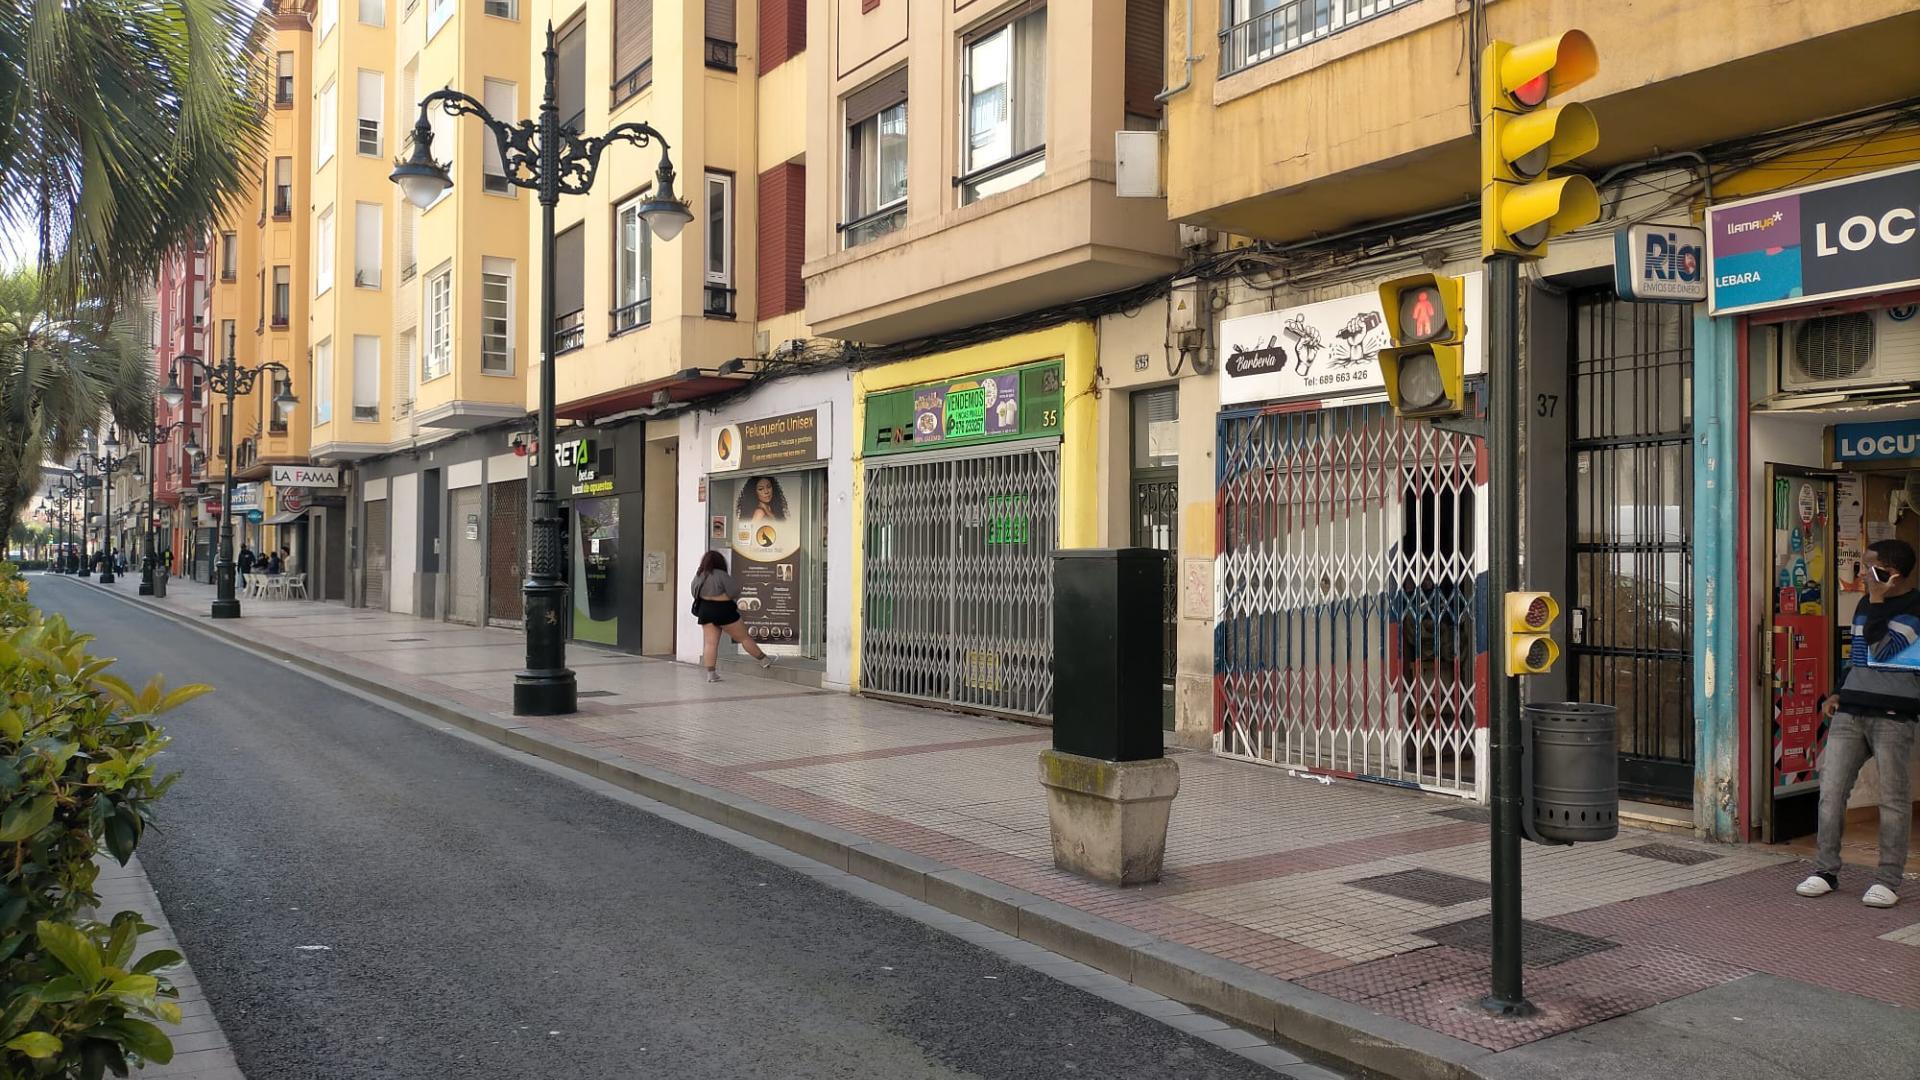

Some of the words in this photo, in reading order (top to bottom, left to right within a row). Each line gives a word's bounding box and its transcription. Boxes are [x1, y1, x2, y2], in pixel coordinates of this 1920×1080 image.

[1816, 208, 1920, 257] LOC
[1645, 233, 1701, 281] Ria
[1668, 284, 1678, 293] DE
[1679, 285, 1700, 294] DINERO
[1715, 272, 1761, 288] LEBARA
[1304, 377, 1318, 387] Tel:
[1320, 375, 1333, 385] 689
[1336, 373, 1350, 383] 663
[1353, 370, 1368, 380] 426
[946, 390, 984, 411] VENDEMOS
[1537, 393, 1558, 418] 37
[787, 416, 814, 432] Unisex
[1043, 409, 1057, 427] 35
[555, 438, 588, 477] RETA
[274, 470, 291, 482] LA
[295, 470, 335, 483] FAMA
